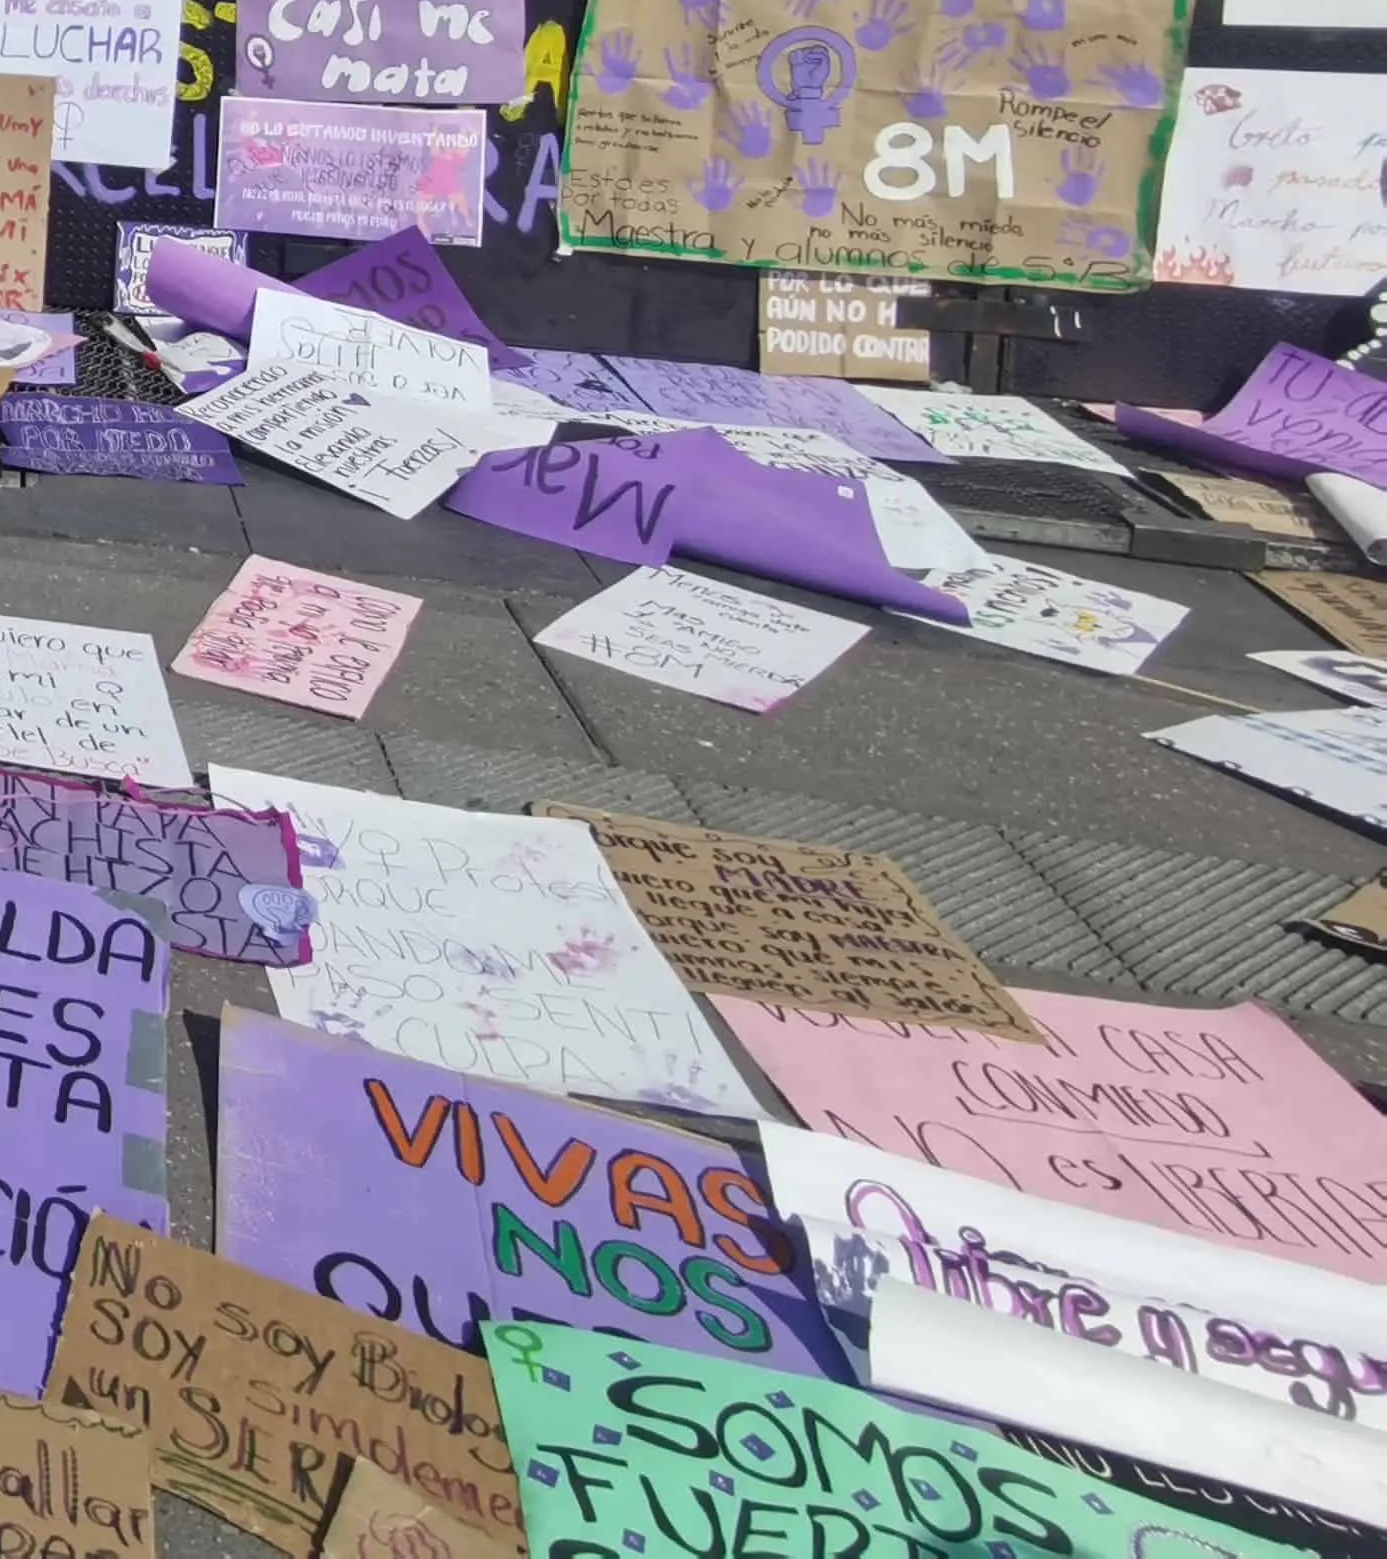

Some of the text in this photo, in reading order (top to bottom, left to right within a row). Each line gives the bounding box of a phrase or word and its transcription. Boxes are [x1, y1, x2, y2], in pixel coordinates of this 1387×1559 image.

[419, 0, 496, 44] me
[1, 25, 163, 64] LUCHAR
[322, 53, 469, 97] mata
[999, 88, 1079, 122] Rompe
[8, 158, 38, 174] una
[864, 122, 1014, 201] 8M
[842, 202, 877, 228] No
[578, 209, 925, 269] Maestra alumnos
[767, 294, 866, 323] AÚN NO
[767, 326, 846, 355] PODIDO
[83, 642, 145, 665] que
[10, 670, 57, 688] mi
[71, 699, 119, 715] en
[79, 734, 116, 753] de
[1099, 1023, 1265, 1085] CASA
[363, 1076, 795, 1275] VIVAS
[491, 1202, 774, 1353] NOS
[606, 1375, 1075, 1558] SOMOS
